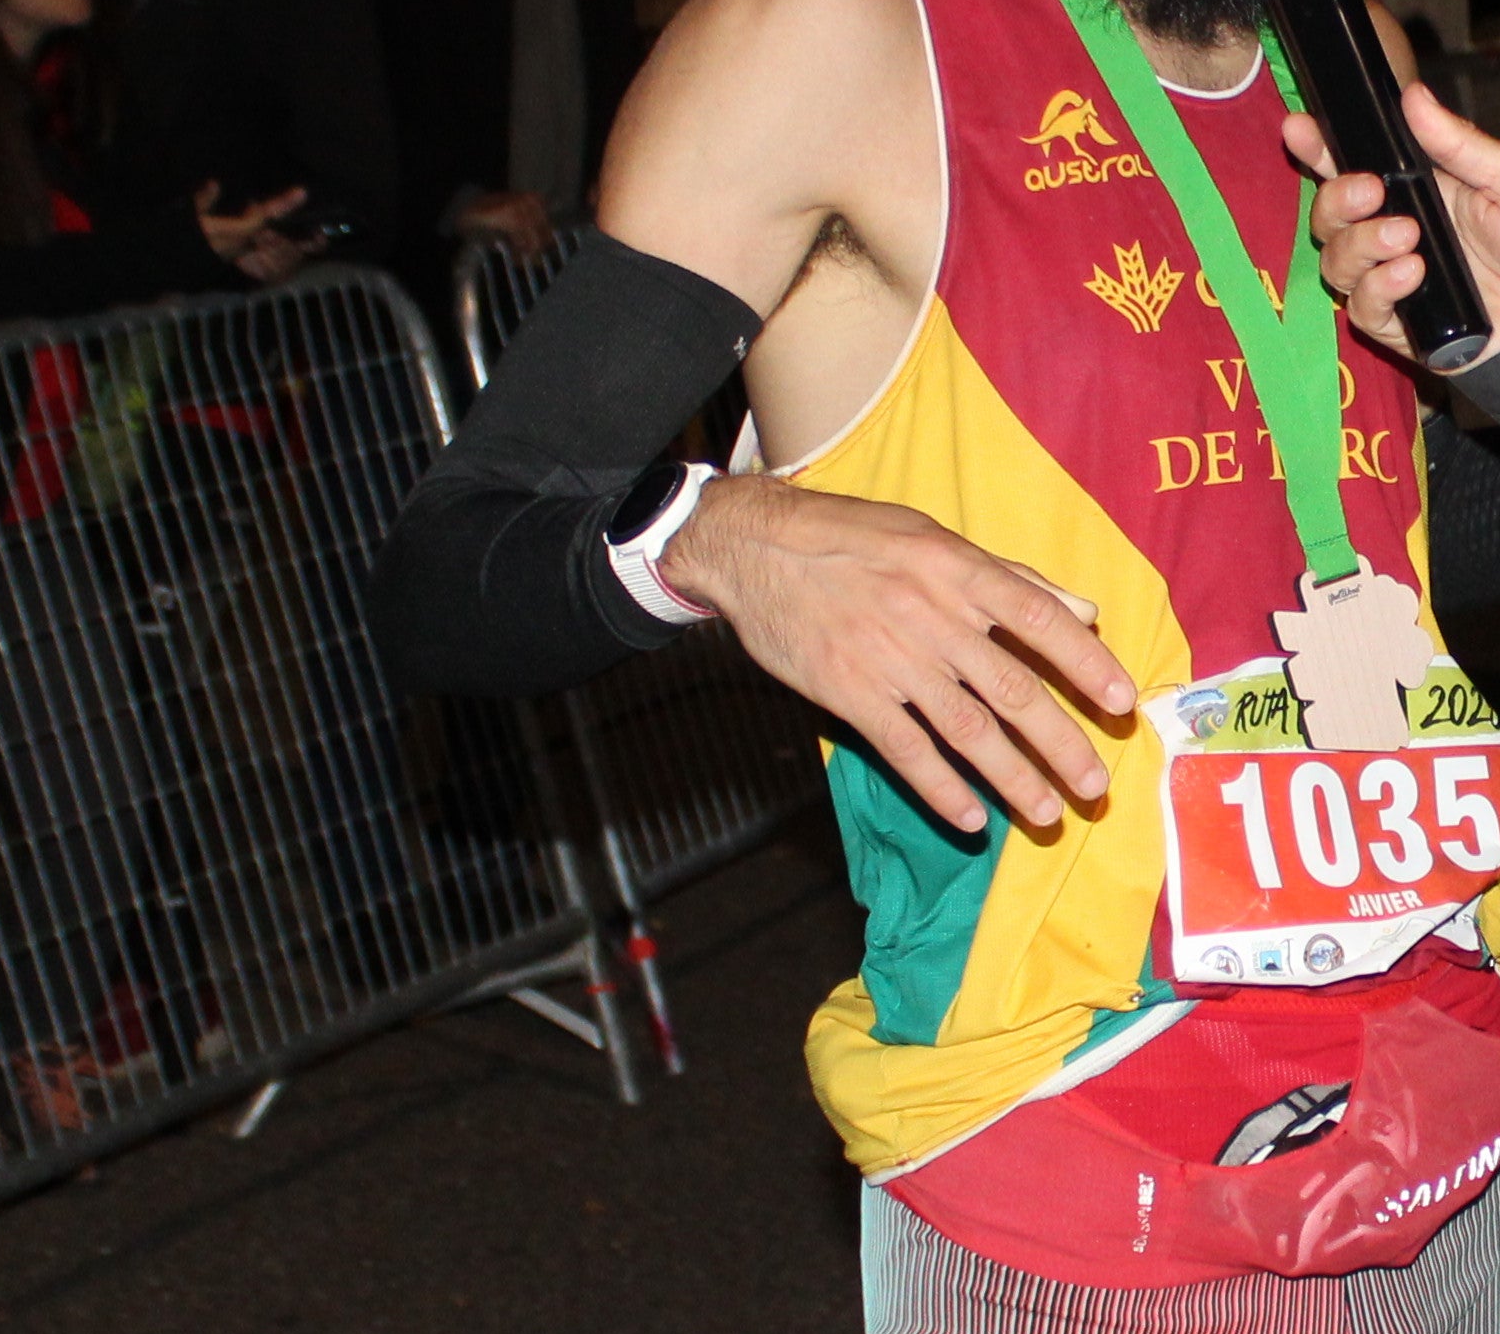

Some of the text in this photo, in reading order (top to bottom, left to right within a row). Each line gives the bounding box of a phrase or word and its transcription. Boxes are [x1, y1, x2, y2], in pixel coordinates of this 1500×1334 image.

[1025, 154, 1154, 191] austral
[1149, 431, 1243, 493] DE
[1234, 687, 1289, 735] RUTA
[1348, 889, 1424, 918] JAVIER
